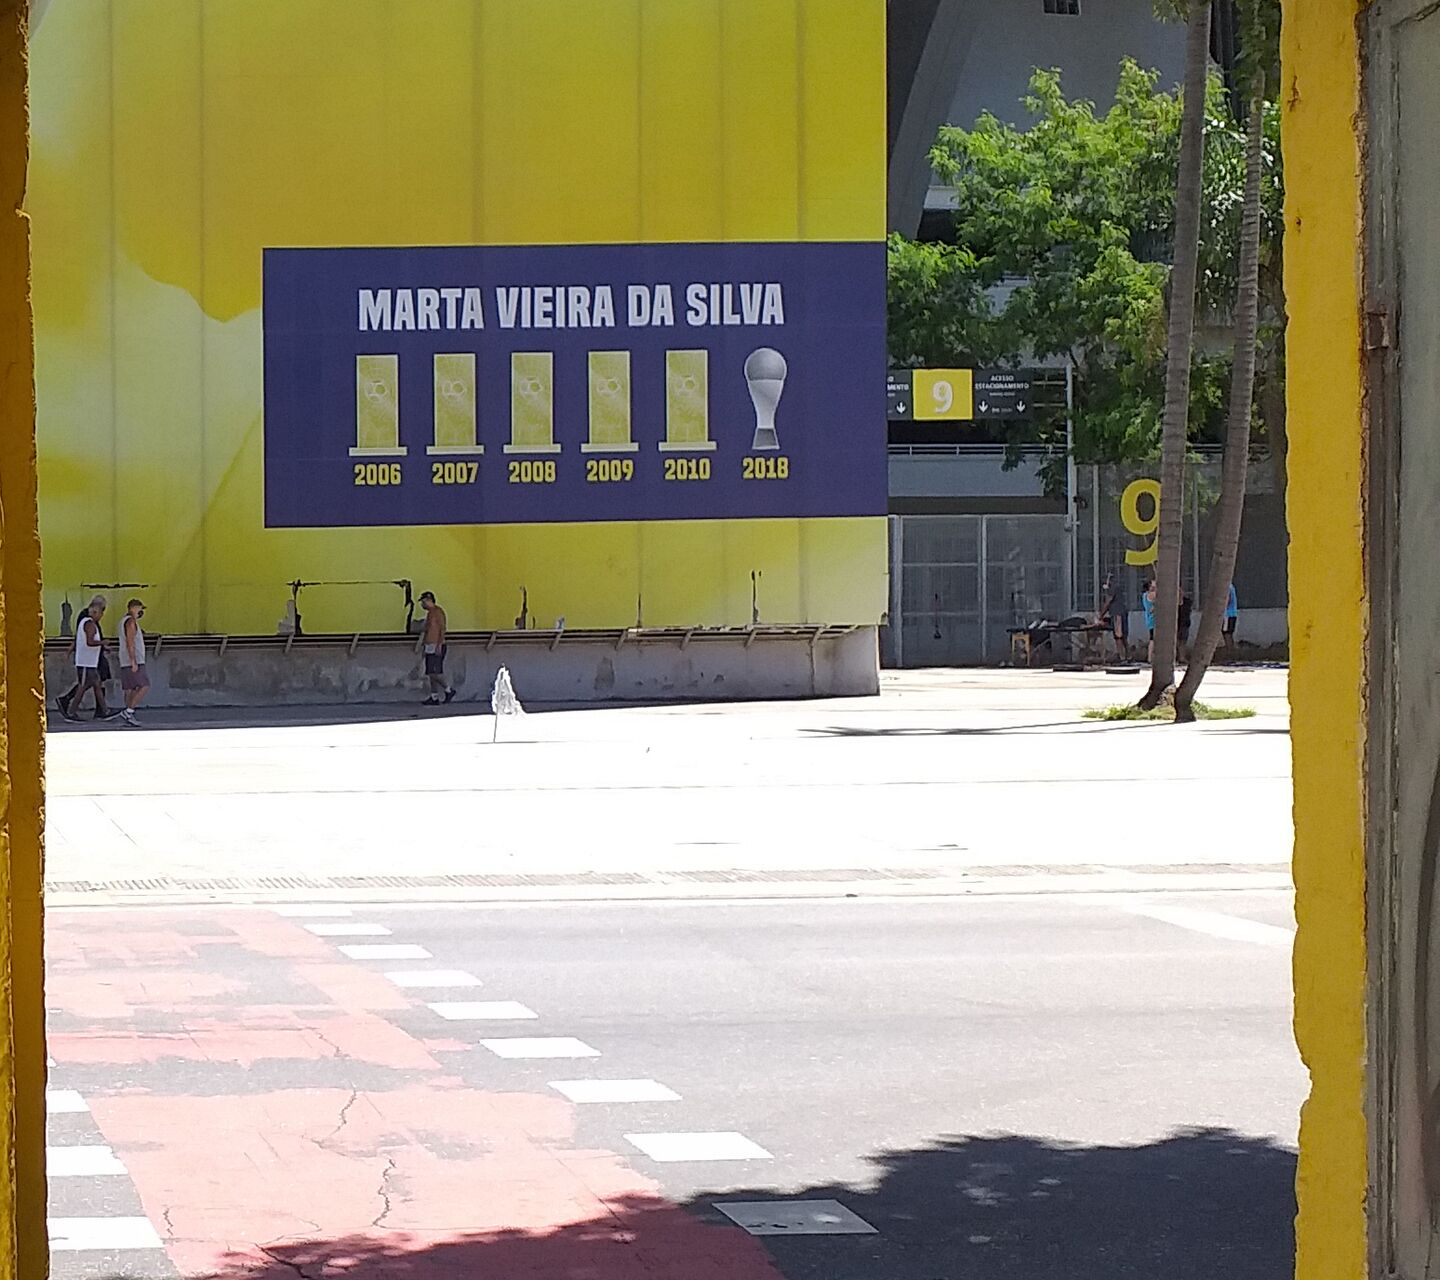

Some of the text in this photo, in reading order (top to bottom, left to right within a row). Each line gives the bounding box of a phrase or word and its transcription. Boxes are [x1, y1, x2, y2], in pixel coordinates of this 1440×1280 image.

[358, 283, 785, 331] MARTA VIEIRA DA SILVA
[932, 380, 954, 414] 9
[354, 457, 789, 486] 2006 2007 2008 2009 2010 2018
[1121, 478, 1162, 567] 9
